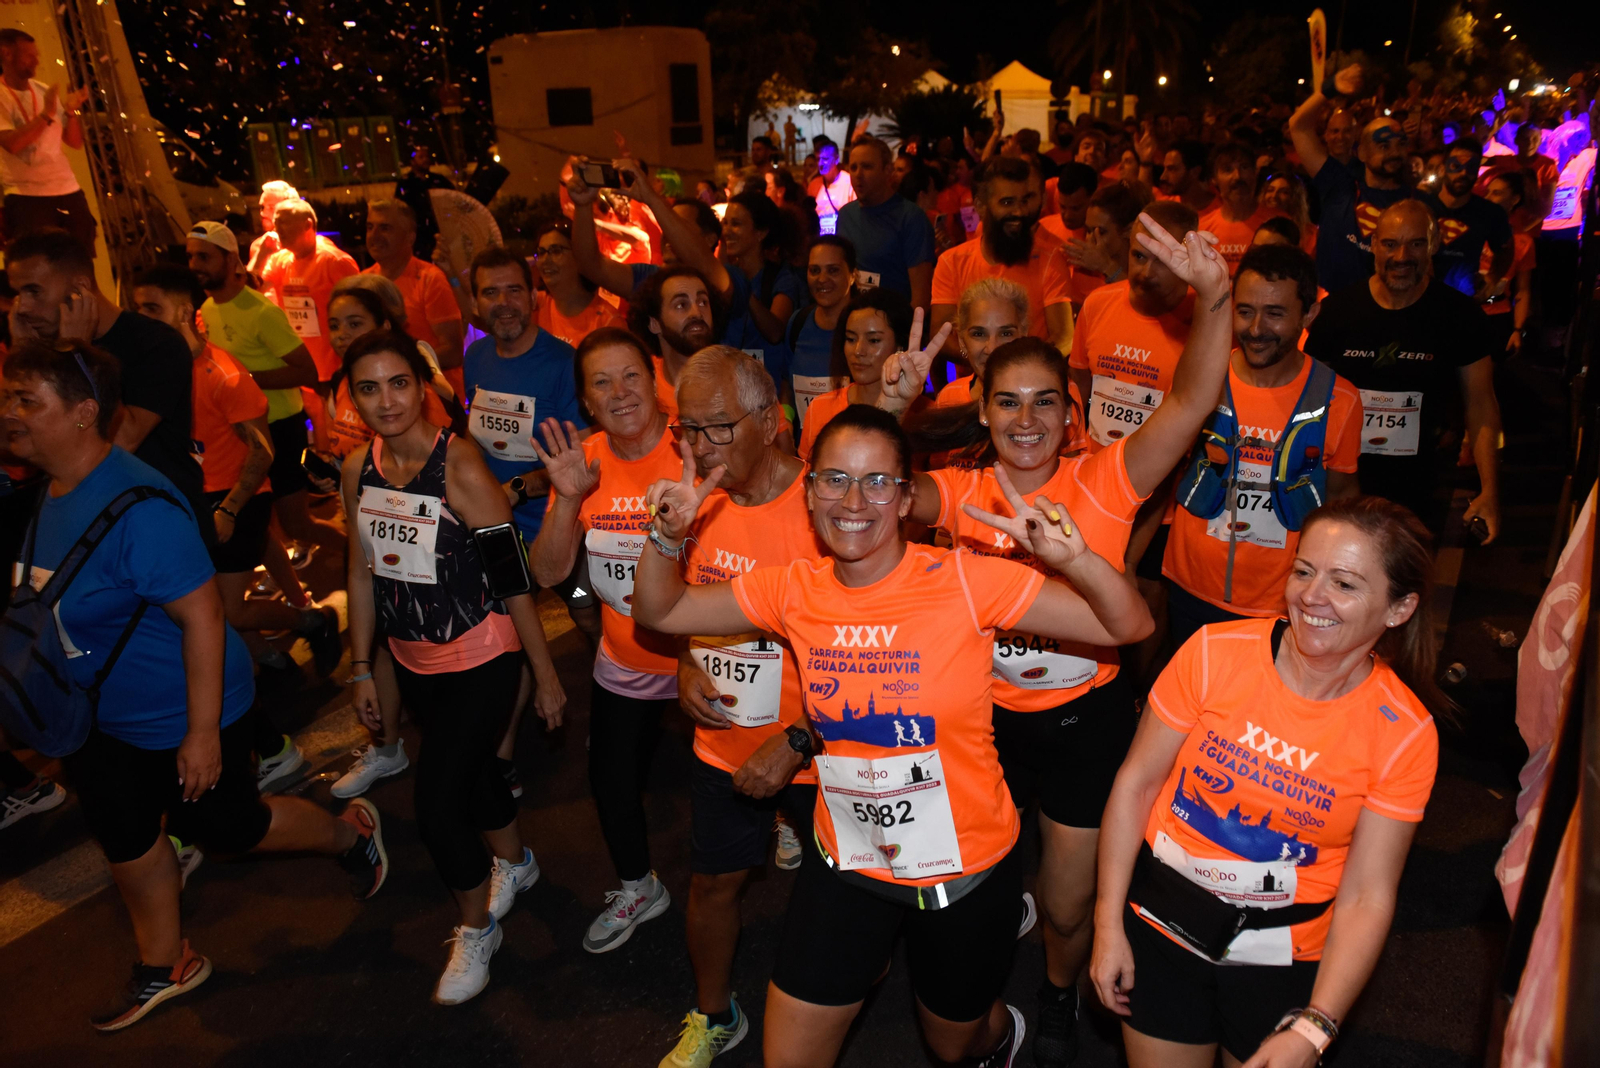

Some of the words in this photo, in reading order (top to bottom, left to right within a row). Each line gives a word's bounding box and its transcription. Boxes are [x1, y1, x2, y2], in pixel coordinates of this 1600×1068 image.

[1220, 244, 1247, 253] XXXV
[1113, 343, 1151, 362] XXXV
[1343, 349, 1375, 358] ZONA
[1398, 351, 1434, 361] ZERO
[1098, 354, 1124, 365] CARRERA
[1127, 361, 1159, 373] NOCTURNA
[1101, 361, 1158, 380] GUADALQUIVIR
[1101, 401, 1143, 425] 19283
[1365, 413, 1406, 428] 7154
[479, 414, 520, 434] 15559
[610, 496, 646, 512] XXX
[1237, 493, 1274, 512] 074
[630, 513, 653, 521] NOCT
[369, 519, 419, 545] 18152
[714, 547, 757, 573] XXXV
[407, 571, 433, 580] Cruzcampo
[603, 561, 636, 581] 181
[698, 564, 726, 579] CARRERA
[831, 625, 898, 648] XXXV
[998, 634, 1060, 658] 5944
[809, 647, 853, 659] CARRERA
[858, 650, 921, 660] NOCTURNA
[702, 654, 761, 684] 18157
[814, 659, 920, 674] GUADALQUIVIR
[1062, 671, 1092, 683] Cruzcampo
[746, 714, 775, 722] Cruzcampo
[1198, 739, 1209, 753] DEL
[1237, 720, 1320, 771] XXXV
[1207, 730, 1259, 766] CARRERA
[1264, 760, 1336, 798] NOCTURNA
[1206, 746, 1333, 813] GUADALQUIVIR
[853, 800, 915, 828] 5982
[1171, 803, 1190, 821] 2023
[917, 858, 954, 869] Cruzcampo
